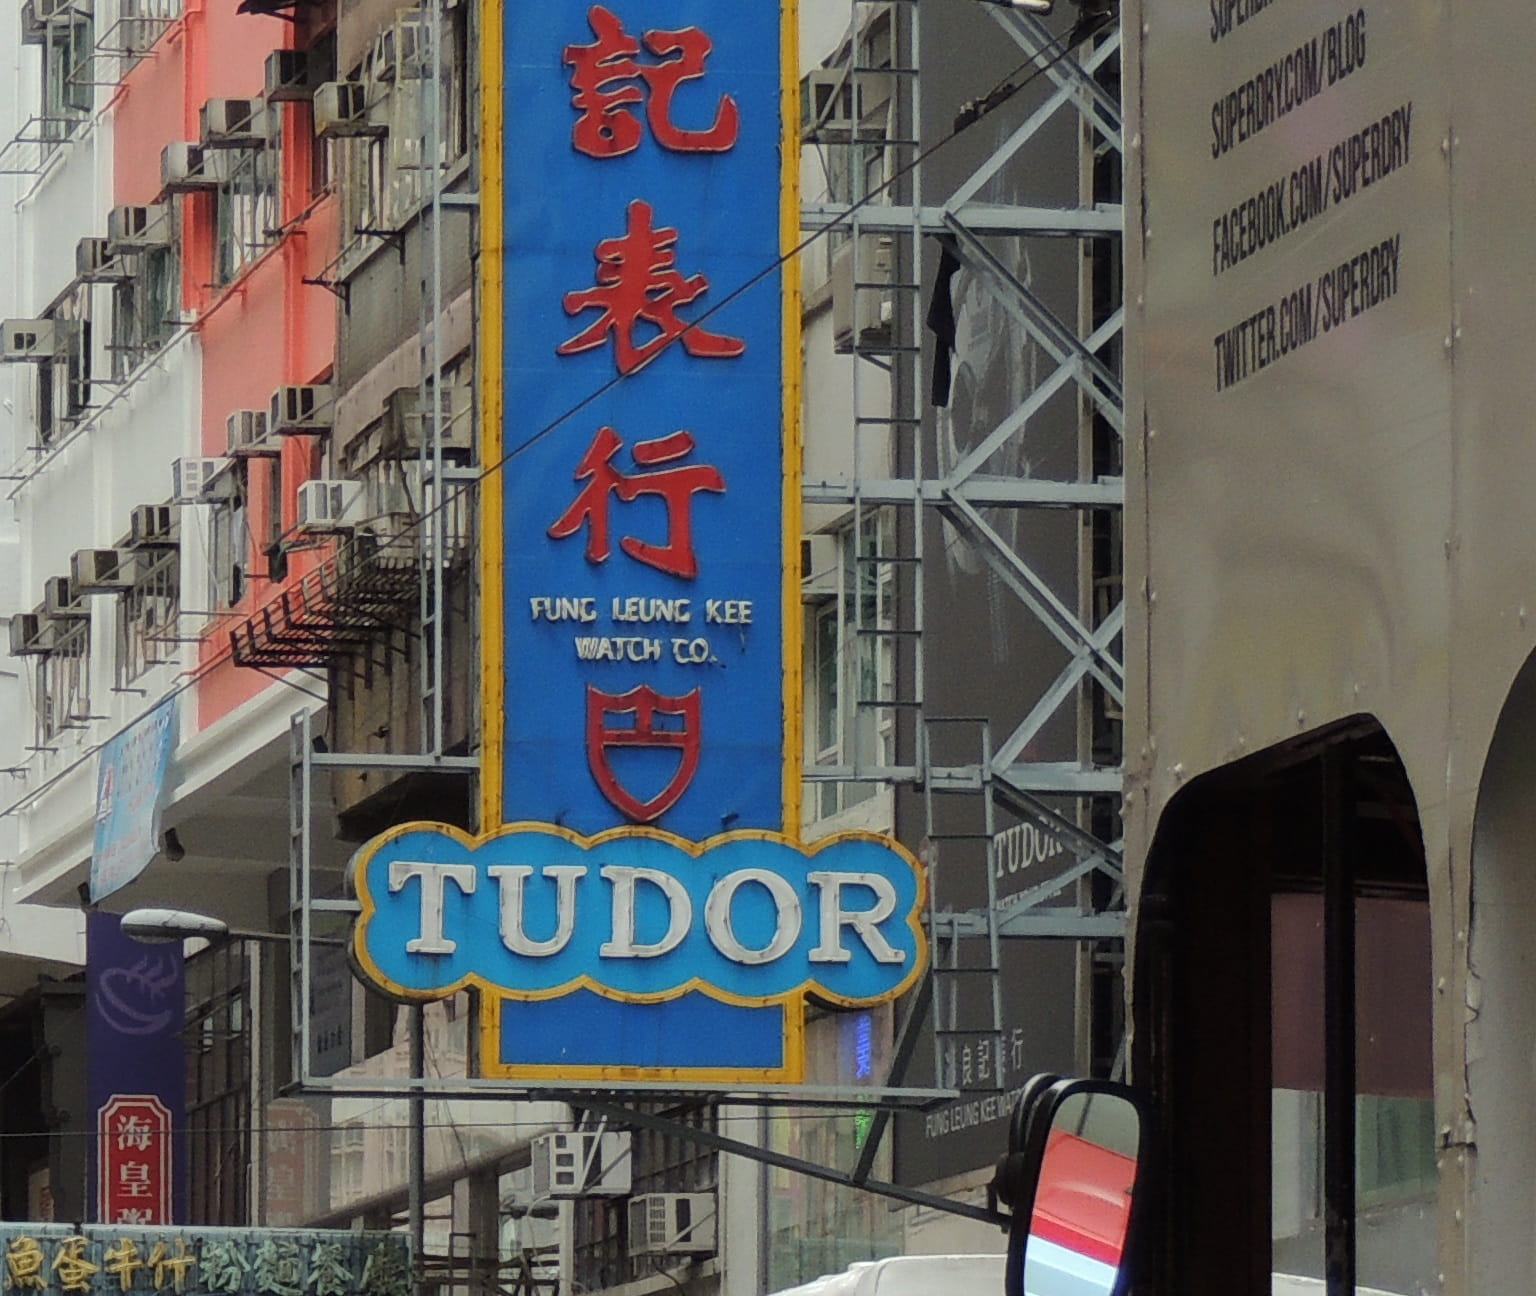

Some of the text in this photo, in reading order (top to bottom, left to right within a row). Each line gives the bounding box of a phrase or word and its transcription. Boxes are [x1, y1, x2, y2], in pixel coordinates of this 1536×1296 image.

[1211, 9, 1366, 159] SUPERDRY.COM/BLOG
[1213, 101, 1413, 276] FACEBOOK.COM/SUPERDRY
[1214, 233, 1401, 393] TWITTER.COM/SUPERDRY
[530, 597, 753, 625] FUNG LEUNG KEE
[575, 636, 661, 663] WATCH
[388, 861, 906, 964] TUDOR
